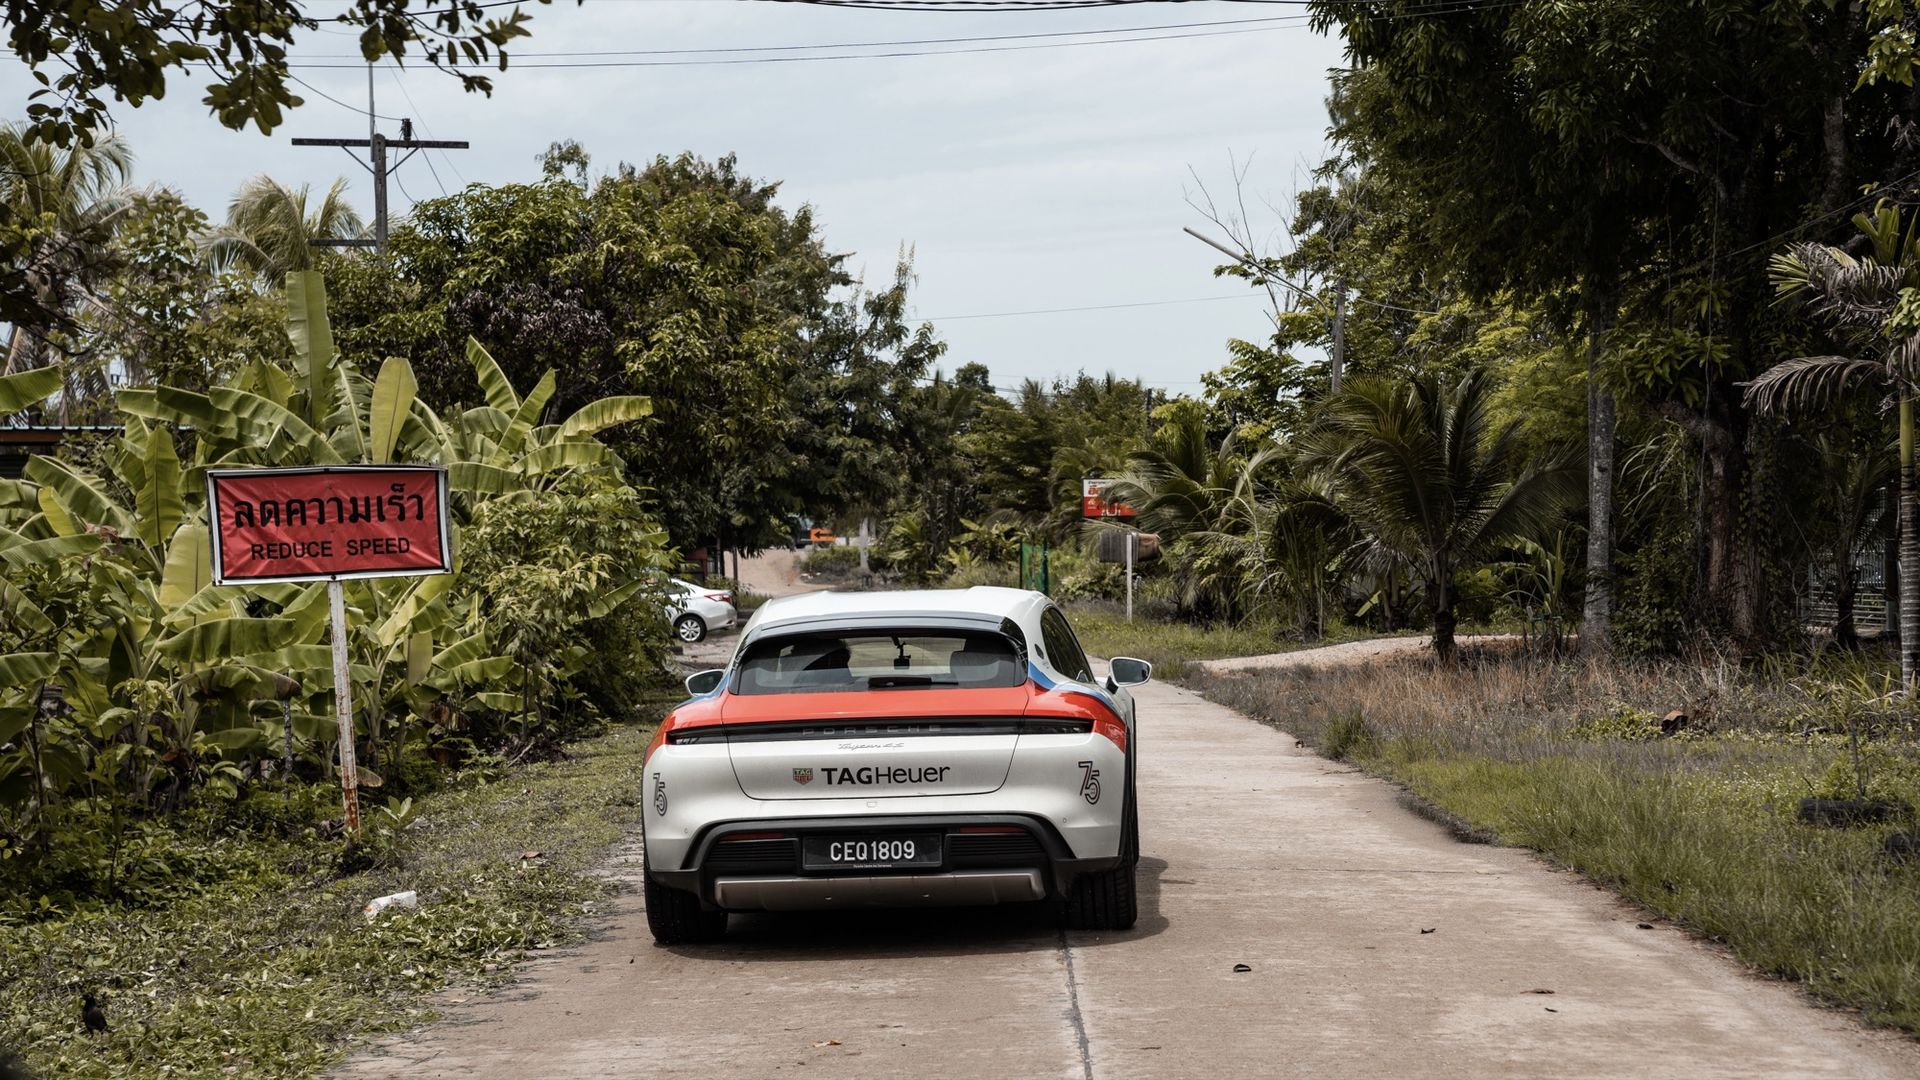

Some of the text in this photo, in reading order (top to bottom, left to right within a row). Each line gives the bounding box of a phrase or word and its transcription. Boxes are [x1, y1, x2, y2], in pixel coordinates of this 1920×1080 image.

[235, 483, 425, 529] ลดความเร็ว
[251, 537, 410, 561] REDUCE SPEED
[802, 725, 942, 736] PORSCHE
[821, 766, 951, 785] TAGHeuer
[1078, 760, 1101, 806] 75
